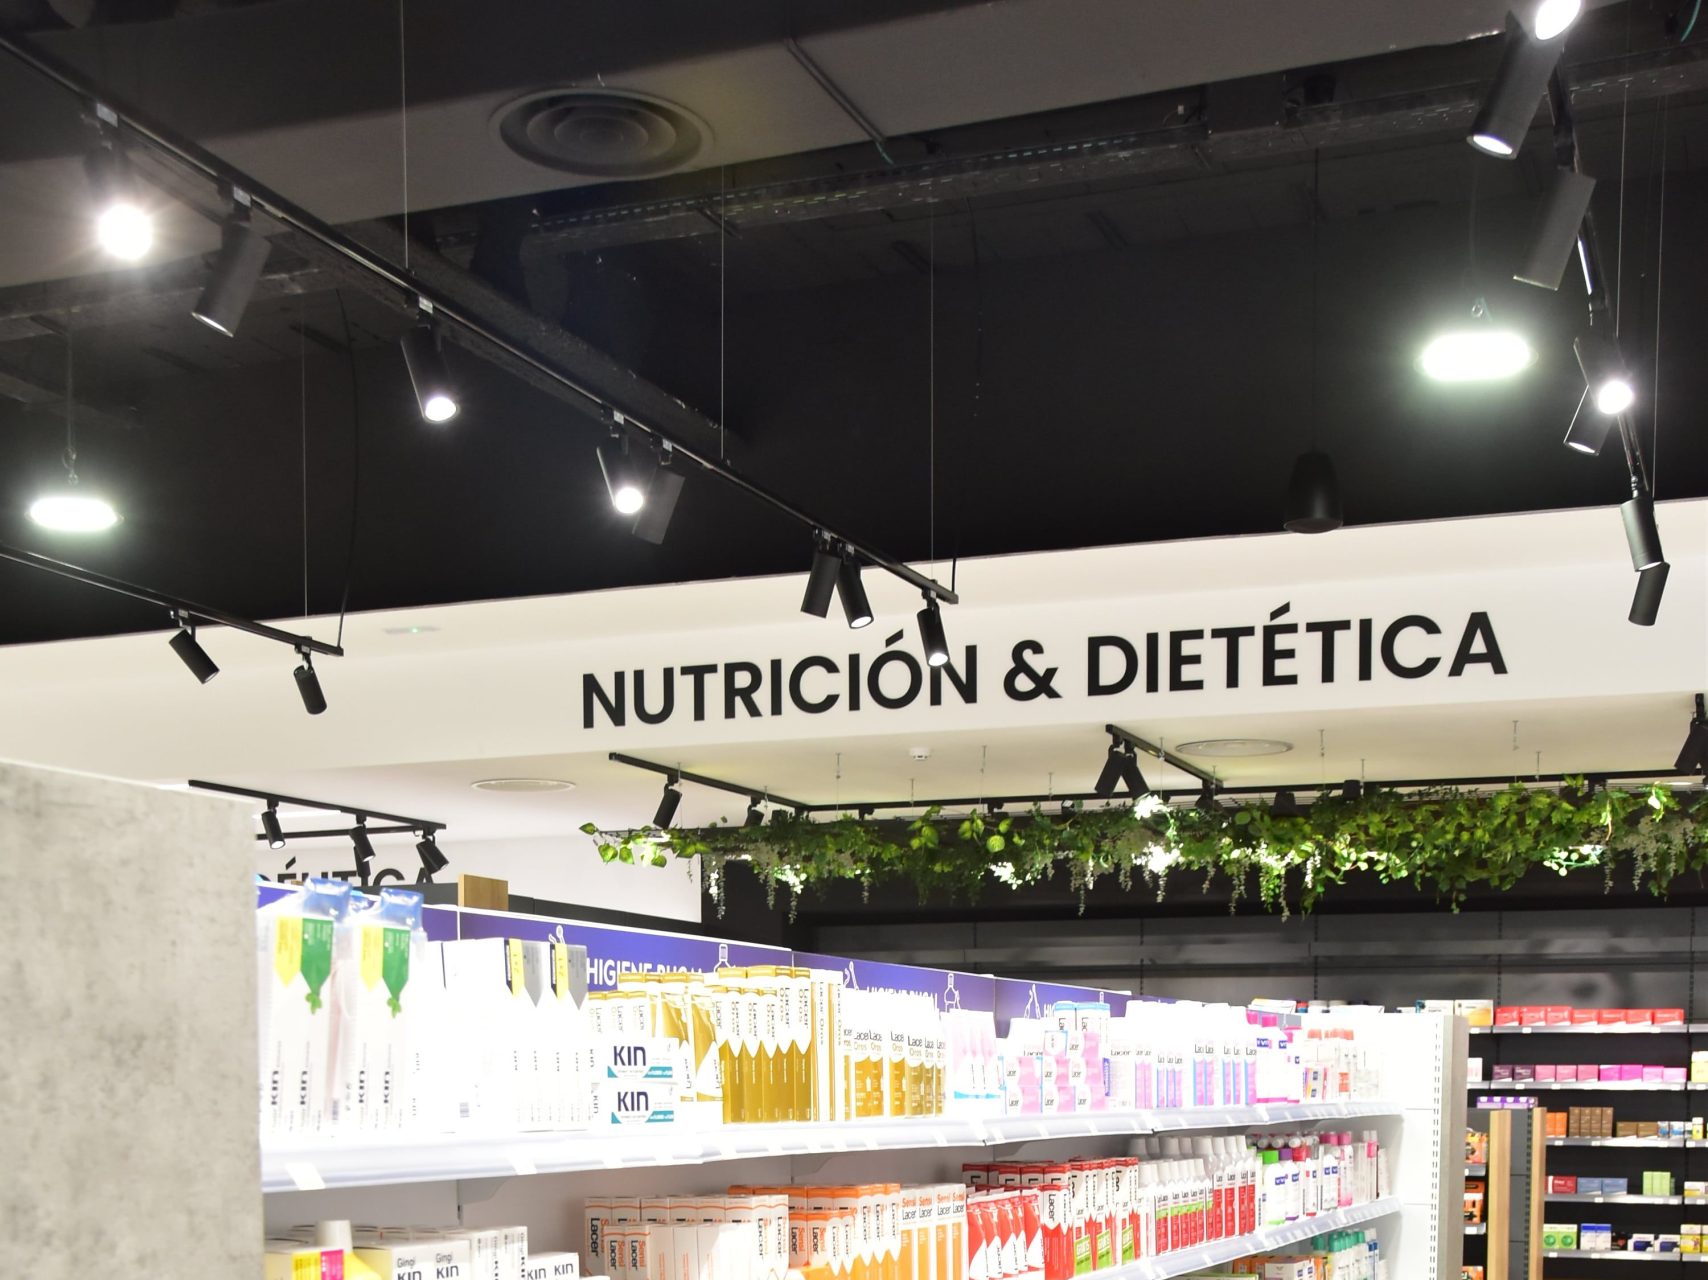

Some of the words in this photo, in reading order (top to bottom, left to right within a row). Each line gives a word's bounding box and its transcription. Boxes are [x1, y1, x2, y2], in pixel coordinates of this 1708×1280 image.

[582, 631, 978, 729] NUTRICIÓN
[1003, 639, 1063, 701] &
[1087, 601, 1509, 697] DIETÉTICA
